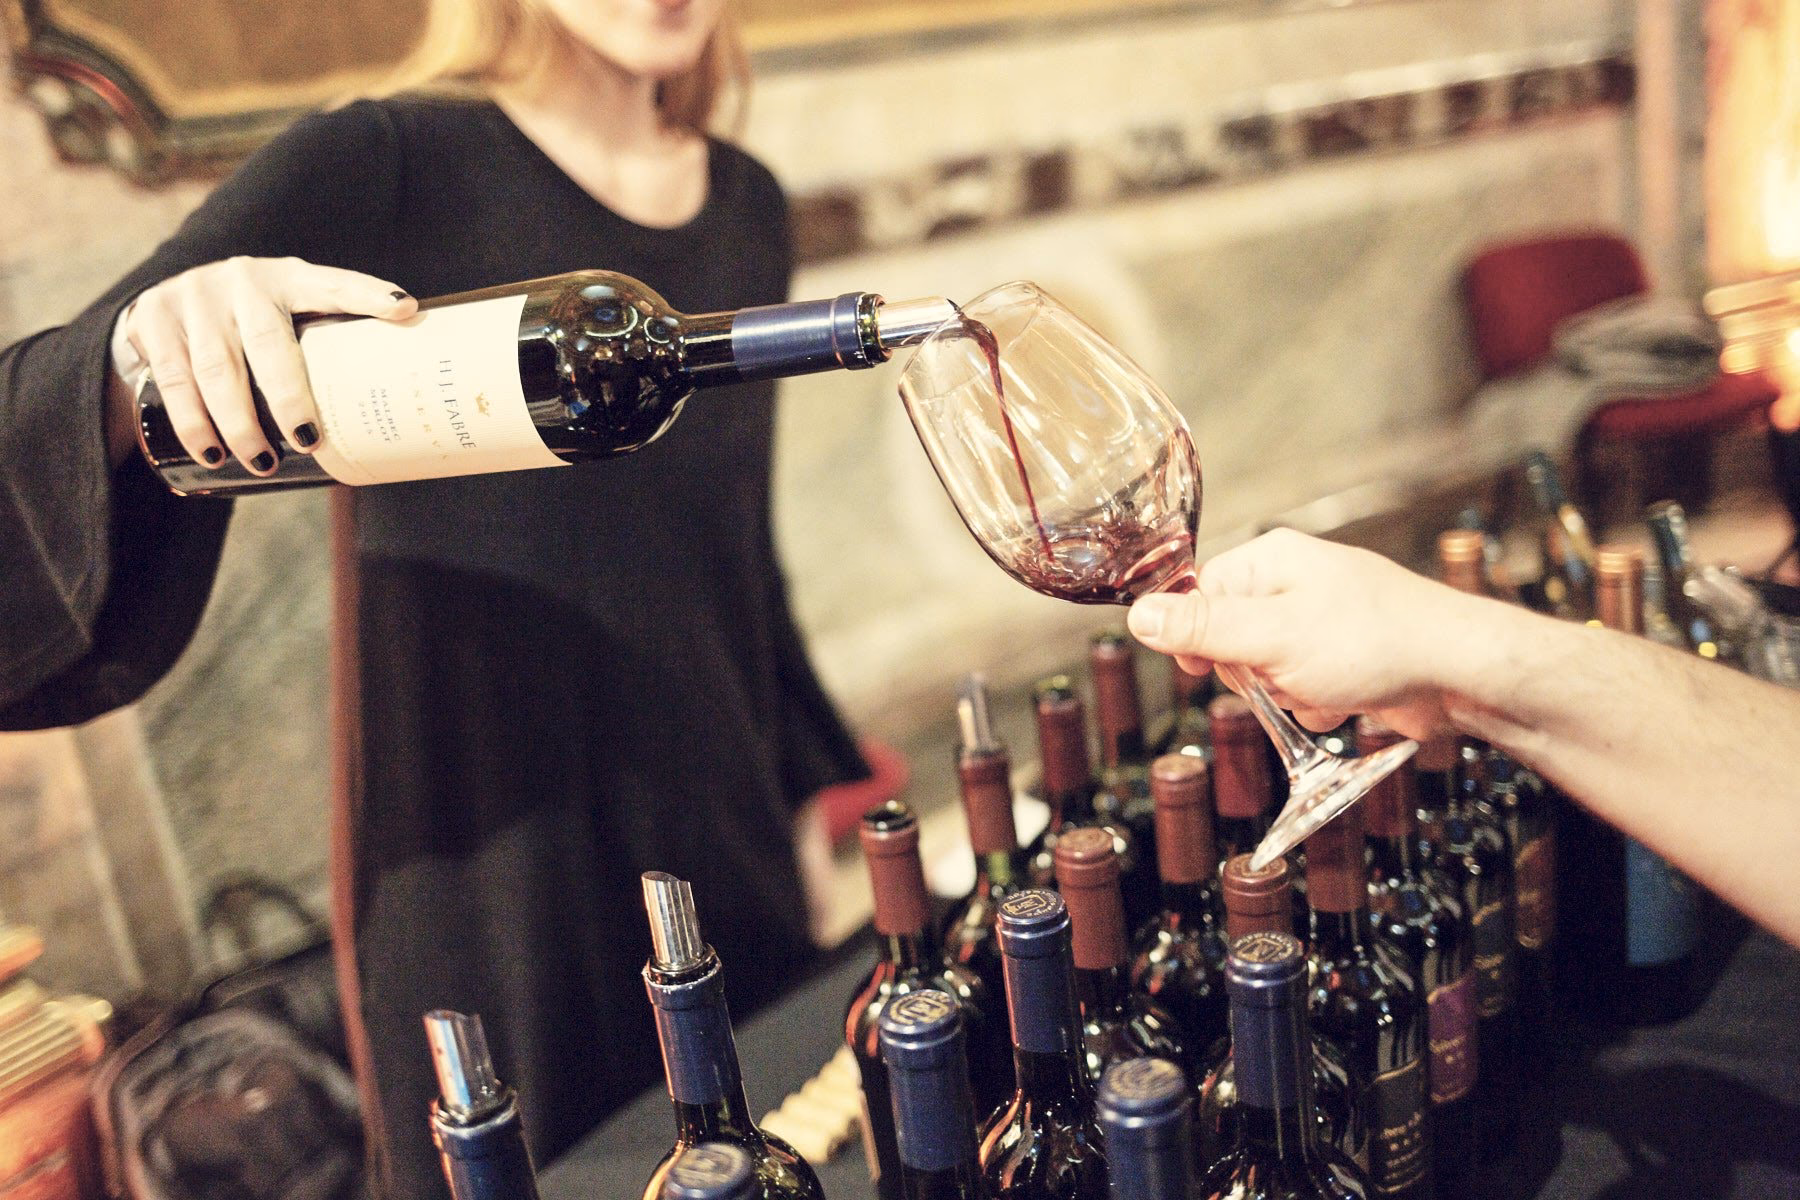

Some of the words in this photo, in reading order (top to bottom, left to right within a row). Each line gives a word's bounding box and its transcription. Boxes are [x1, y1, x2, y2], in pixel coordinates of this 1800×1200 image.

[370, 388, 392, 443] MERLOT
[380, 388, 401, 441] MALBEC
[444, 399, 477, 449] FABRE
